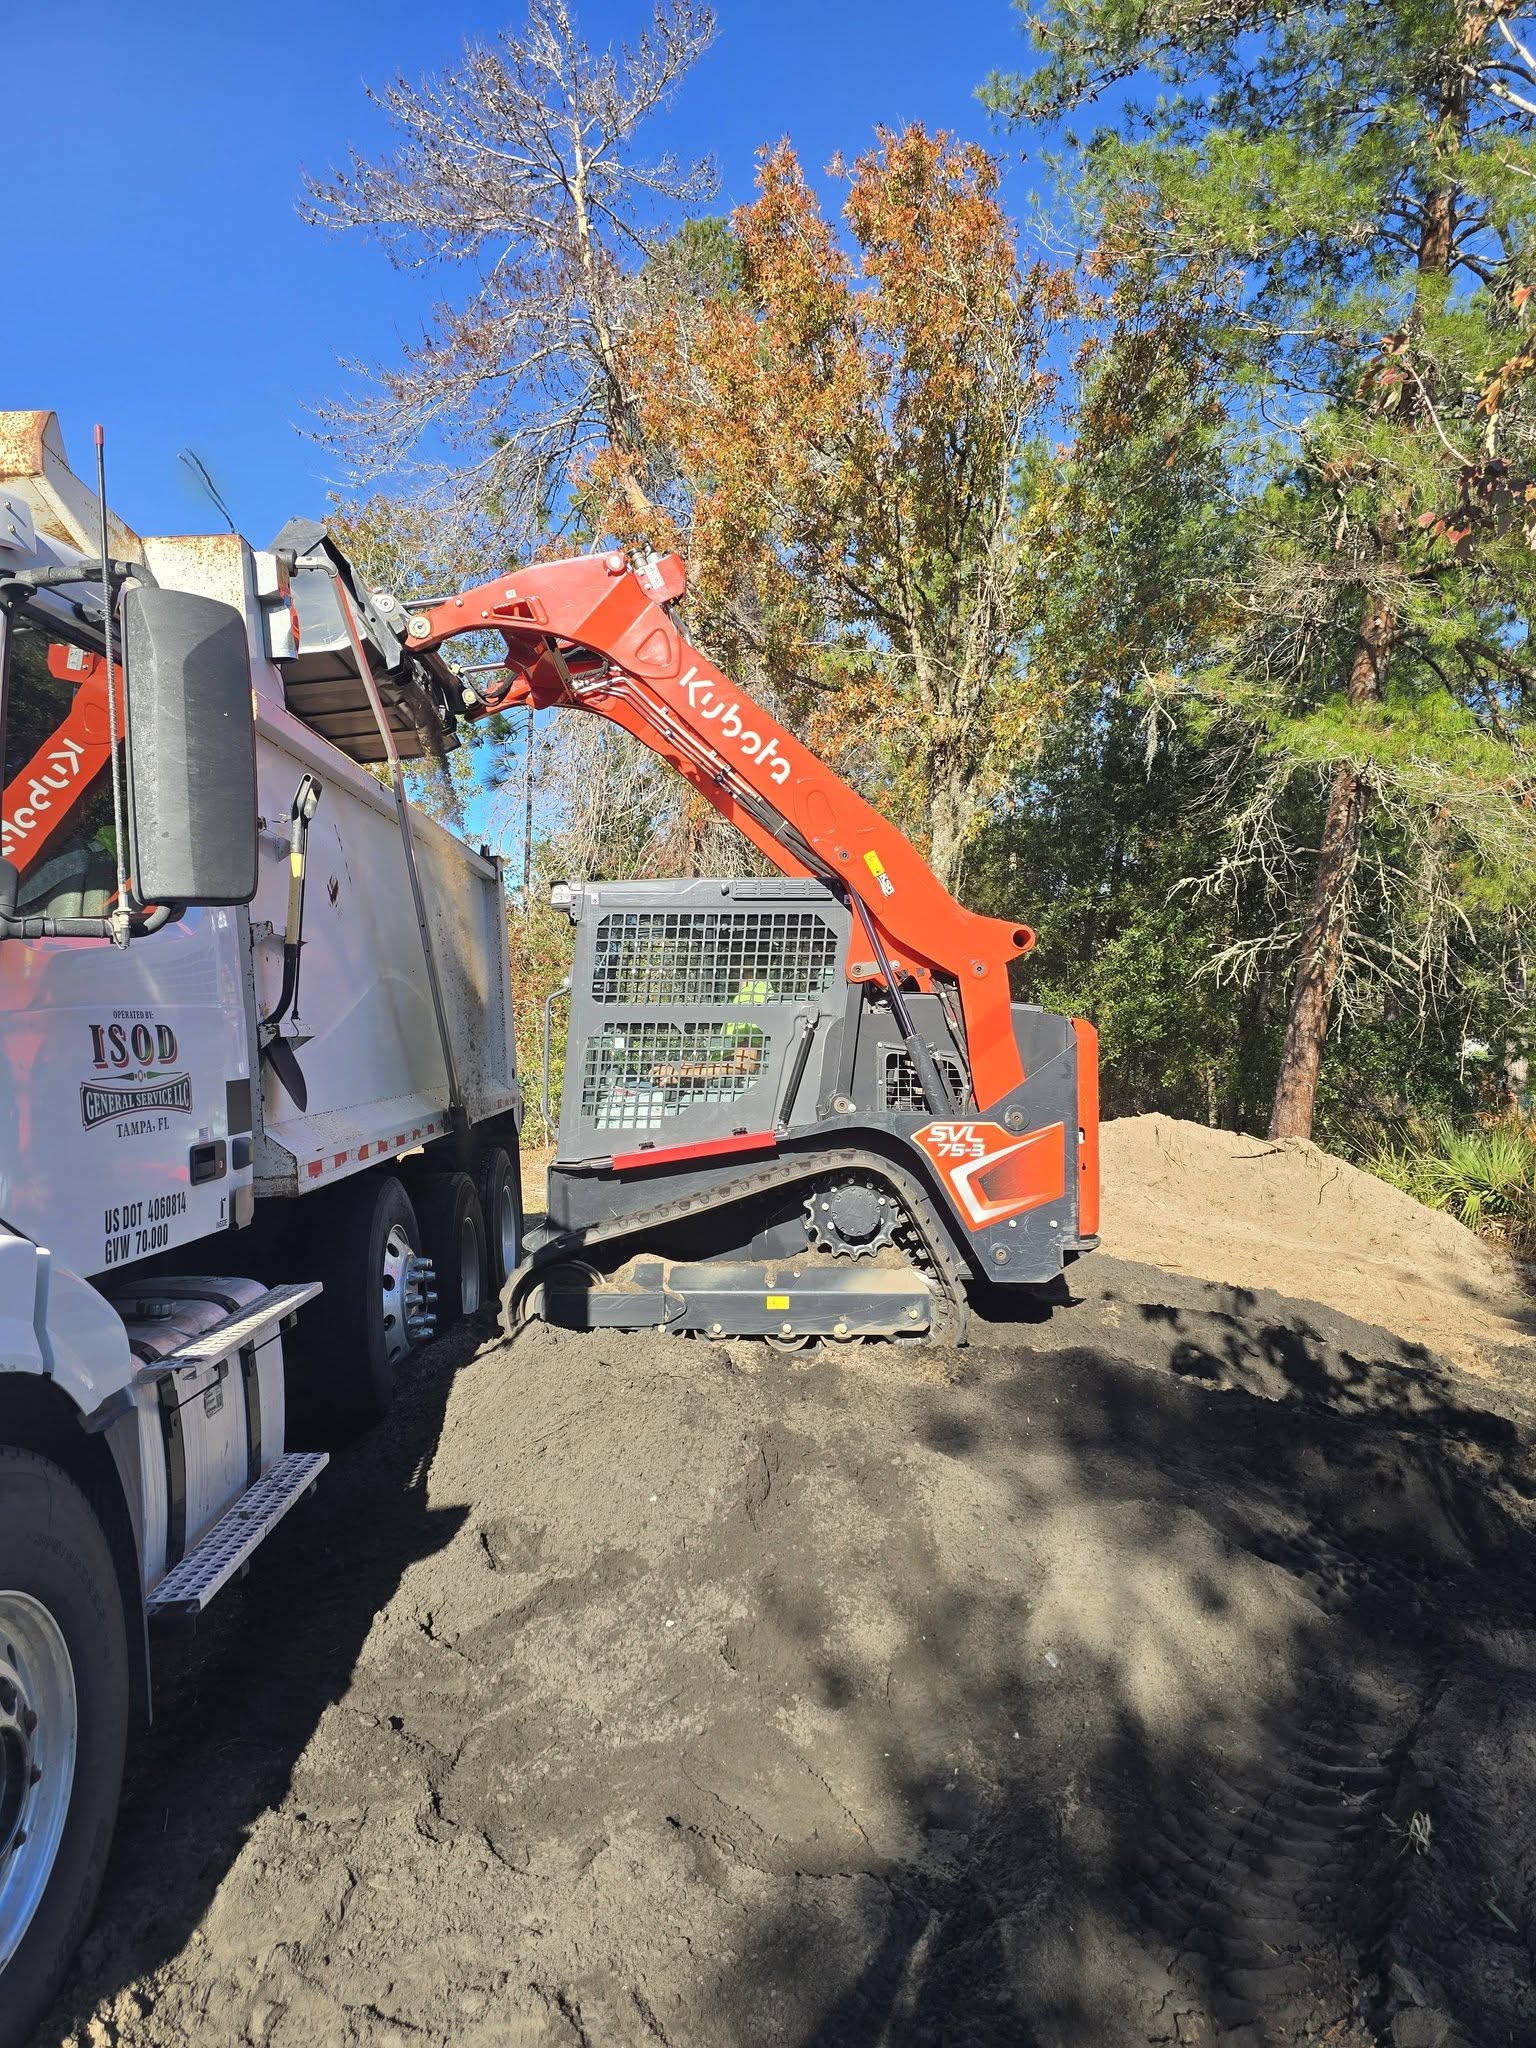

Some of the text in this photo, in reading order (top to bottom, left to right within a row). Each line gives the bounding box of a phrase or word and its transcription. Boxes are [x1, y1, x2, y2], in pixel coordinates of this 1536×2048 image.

[679, 666, 791, 785] Kubota
[112, 1010, 145, 1019] OPERATED
[89, 1024, 178, 1069] ISOD
[85, 1081, 190, 1121] GENERAL SERVICE LLC
[116, 1116, 170, 1138] TAMPA, FL
[927, 1126, 984, 1142] SVL
[937, 1143, 985, 1157] 75-3
[105, 1191, 186, 1235] US DOT 4060814
[105, 1234, 131, 1265] GVW
